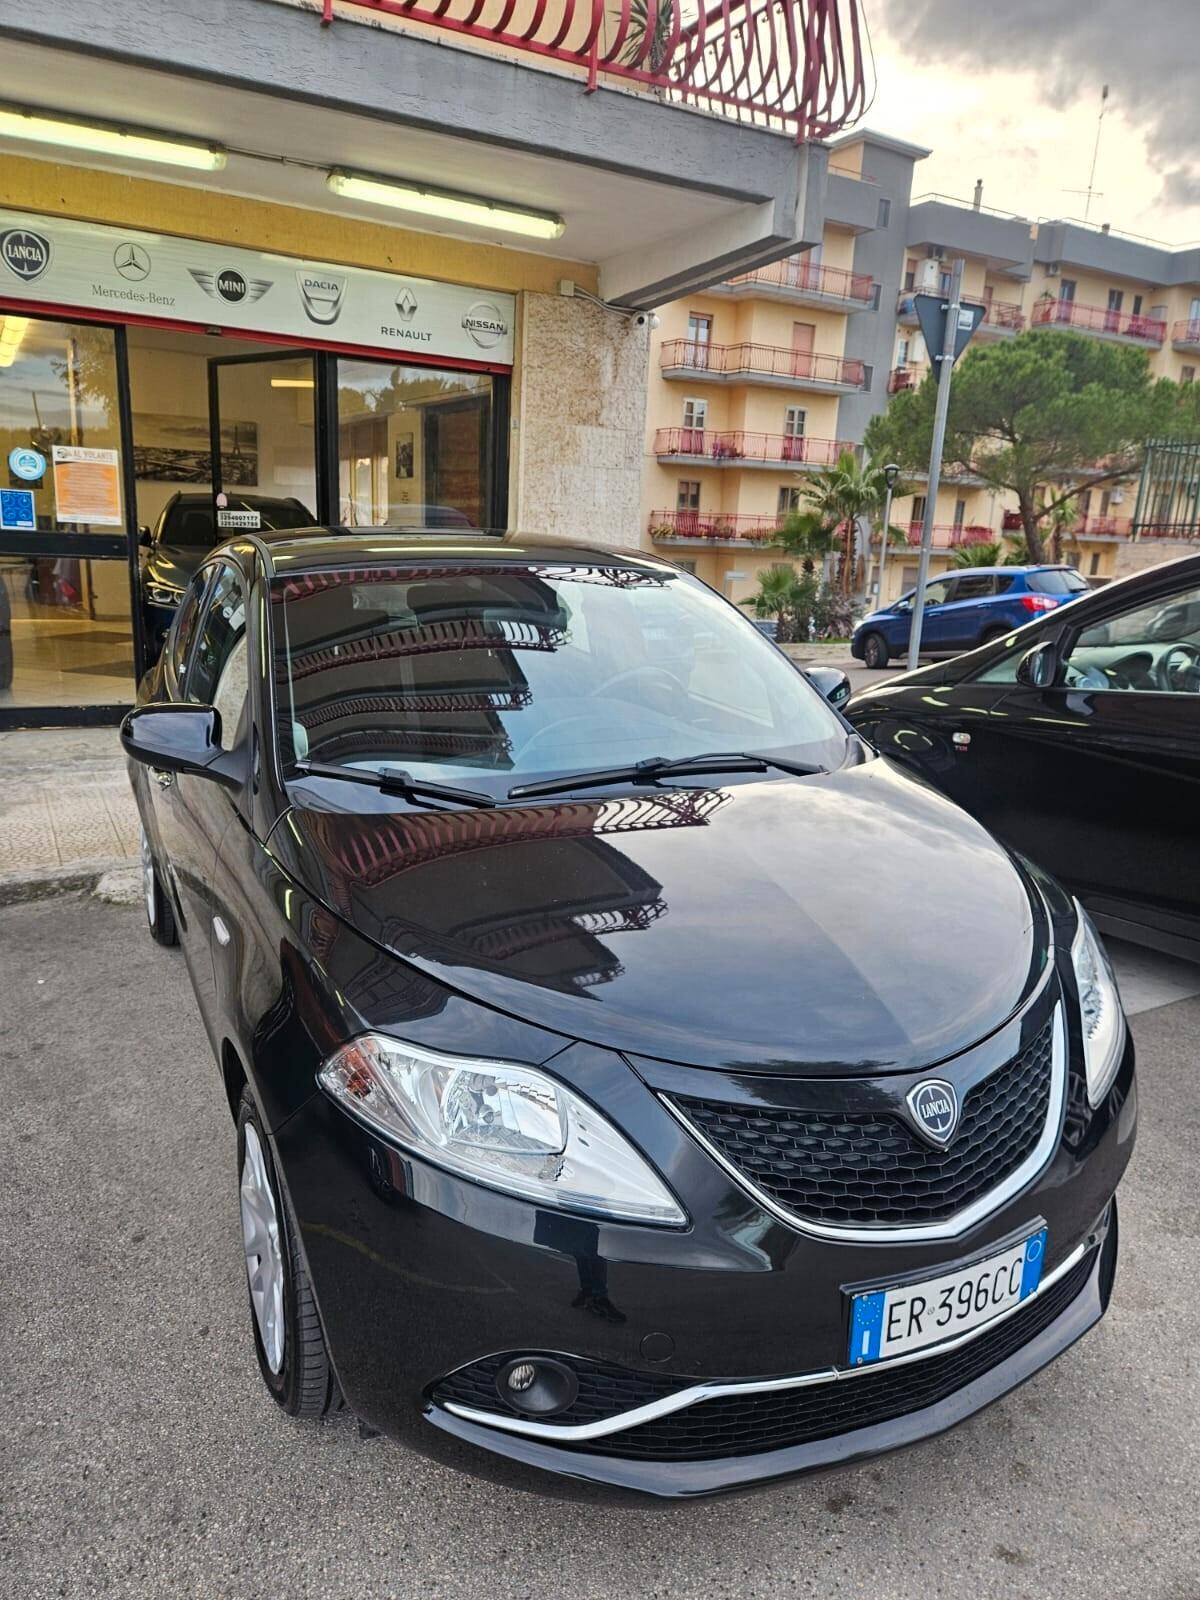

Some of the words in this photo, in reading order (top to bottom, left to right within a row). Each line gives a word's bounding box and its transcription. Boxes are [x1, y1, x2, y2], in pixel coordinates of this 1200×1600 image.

[7, 244, 43, 262] LANCIA
[218, 279, 245, 293] MINI
[304, 279, 339, 291] DACIA
[92, 284, 176, 307] Mercedes-Benz
[465, 318, 504, 331] NISSAN
[381, 326, 432, 342] RENAULT
[921, 1099, 951, 1119] LANCIA
[886, 1297, 927, 1343] ER
[936, 1256, 1024, 1327] 396CC
